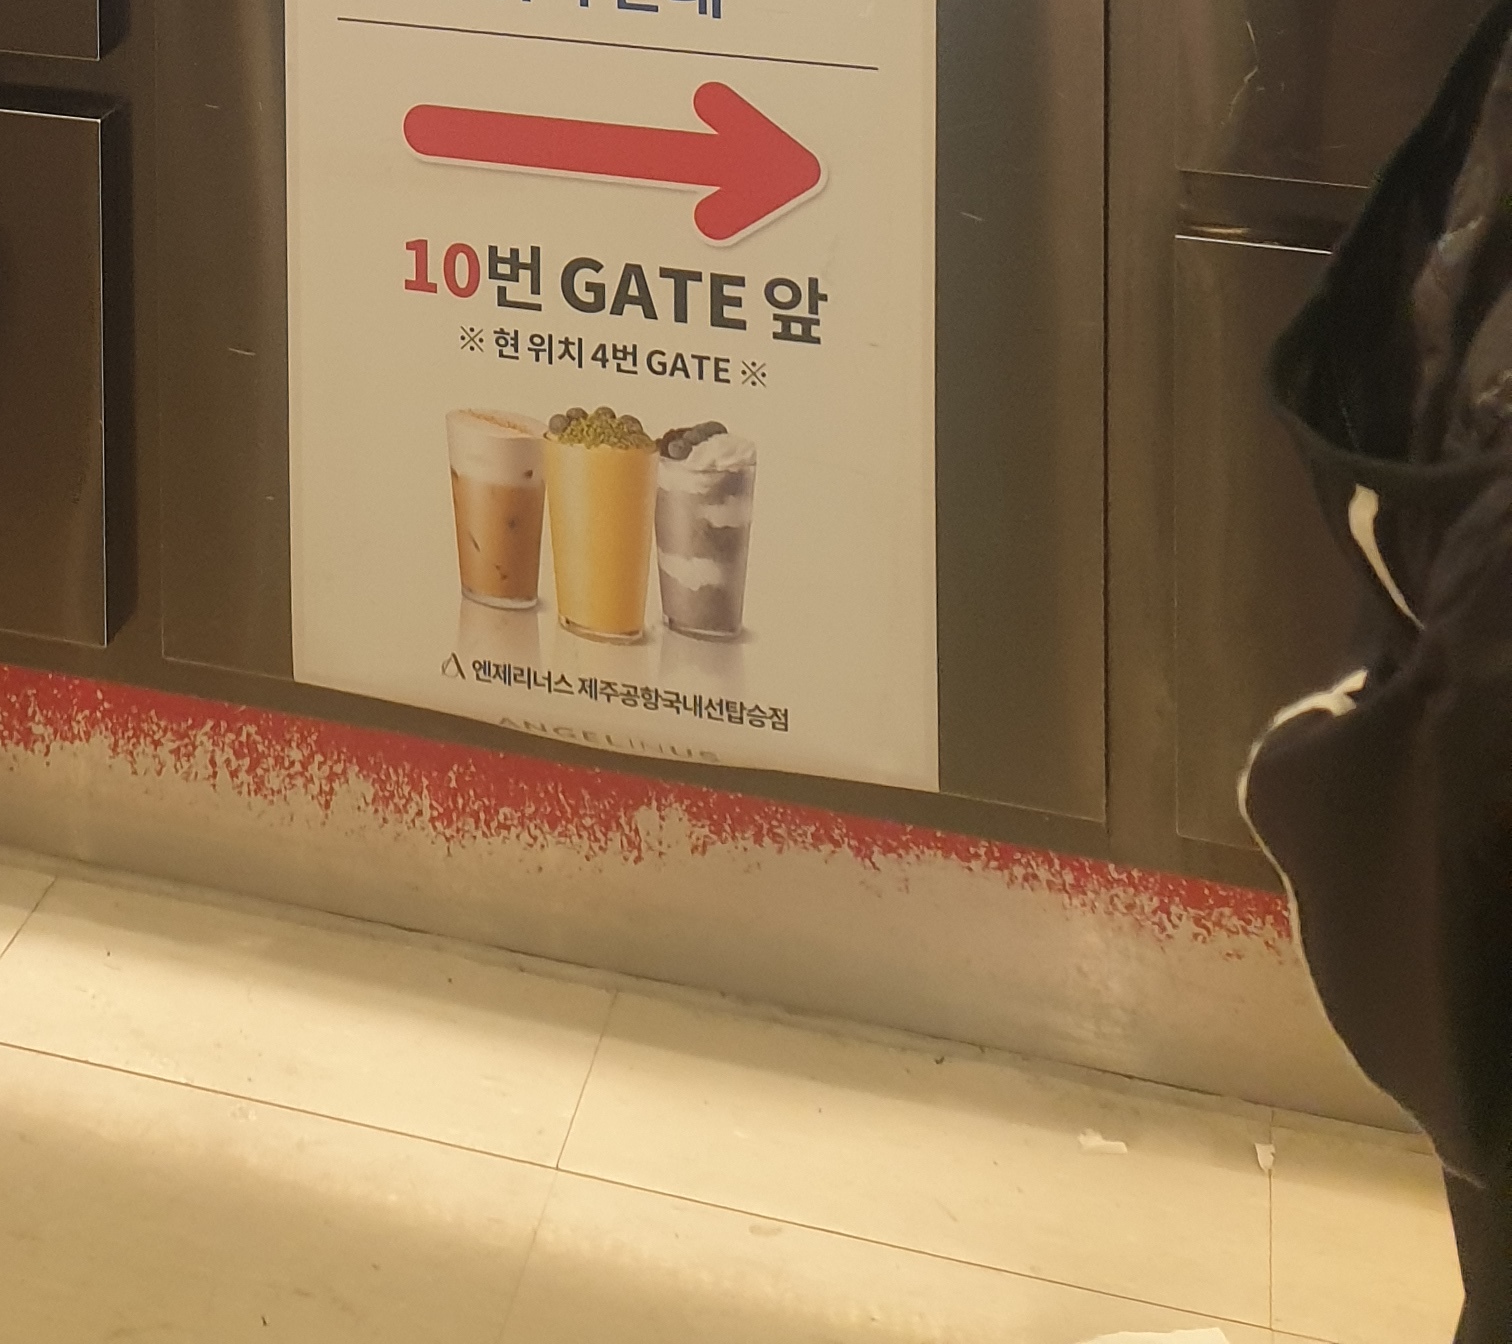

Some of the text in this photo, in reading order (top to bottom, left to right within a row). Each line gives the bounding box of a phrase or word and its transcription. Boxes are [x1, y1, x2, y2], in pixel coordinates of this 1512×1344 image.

[403, 238, 828, 345] 10번 GATE 앞
[493, 327, 520, 360] 현
[527, 333, 583, 369] 위치
[591, 342, 638, 375] 4번
[646, 349, 731, 384] GATE
[472, 659, 789, 733] 엔제리너스 제주공항국내선탑승점
